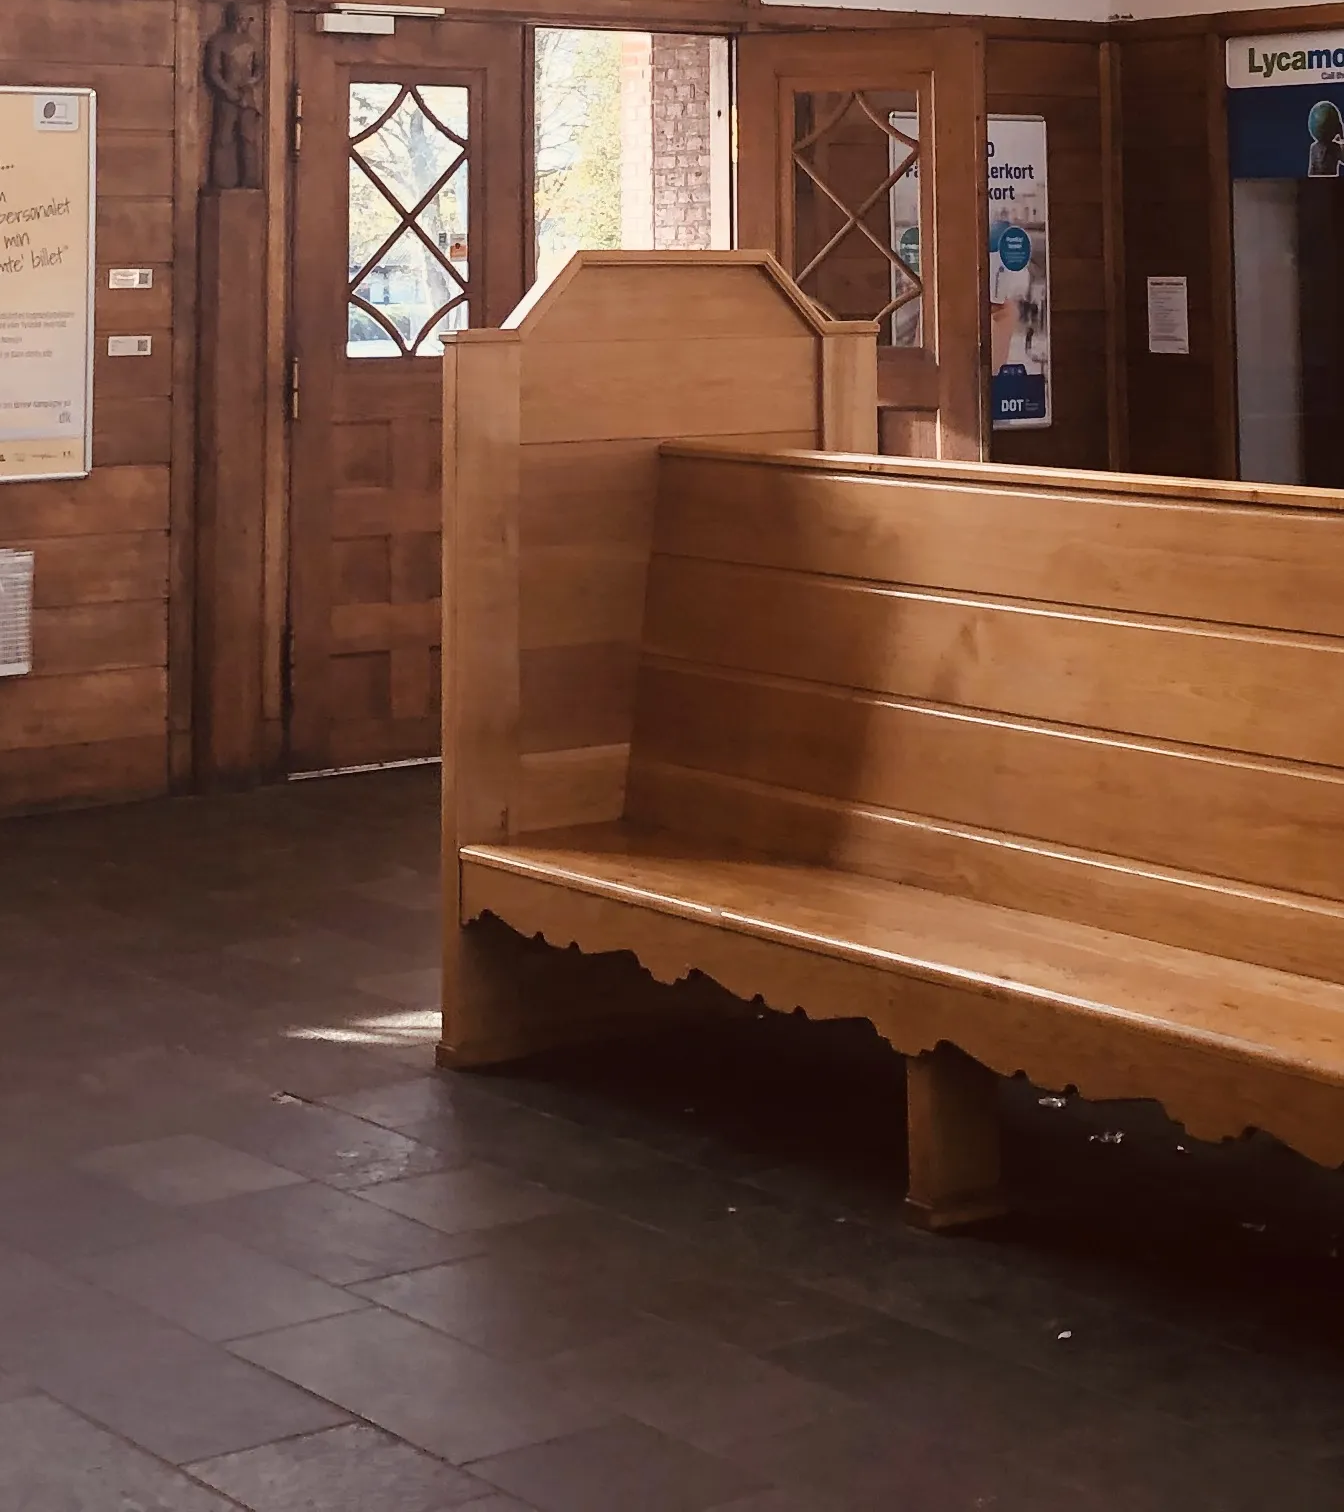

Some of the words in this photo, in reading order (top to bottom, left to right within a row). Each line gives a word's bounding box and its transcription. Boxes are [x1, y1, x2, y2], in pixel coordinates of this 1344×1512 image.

[1321, 71, 1335, 80] Call
[988, 163, 1034, 180] erkort
[3, 231, 31, 249] min
[1001, 399, 1024, 412] DOT
